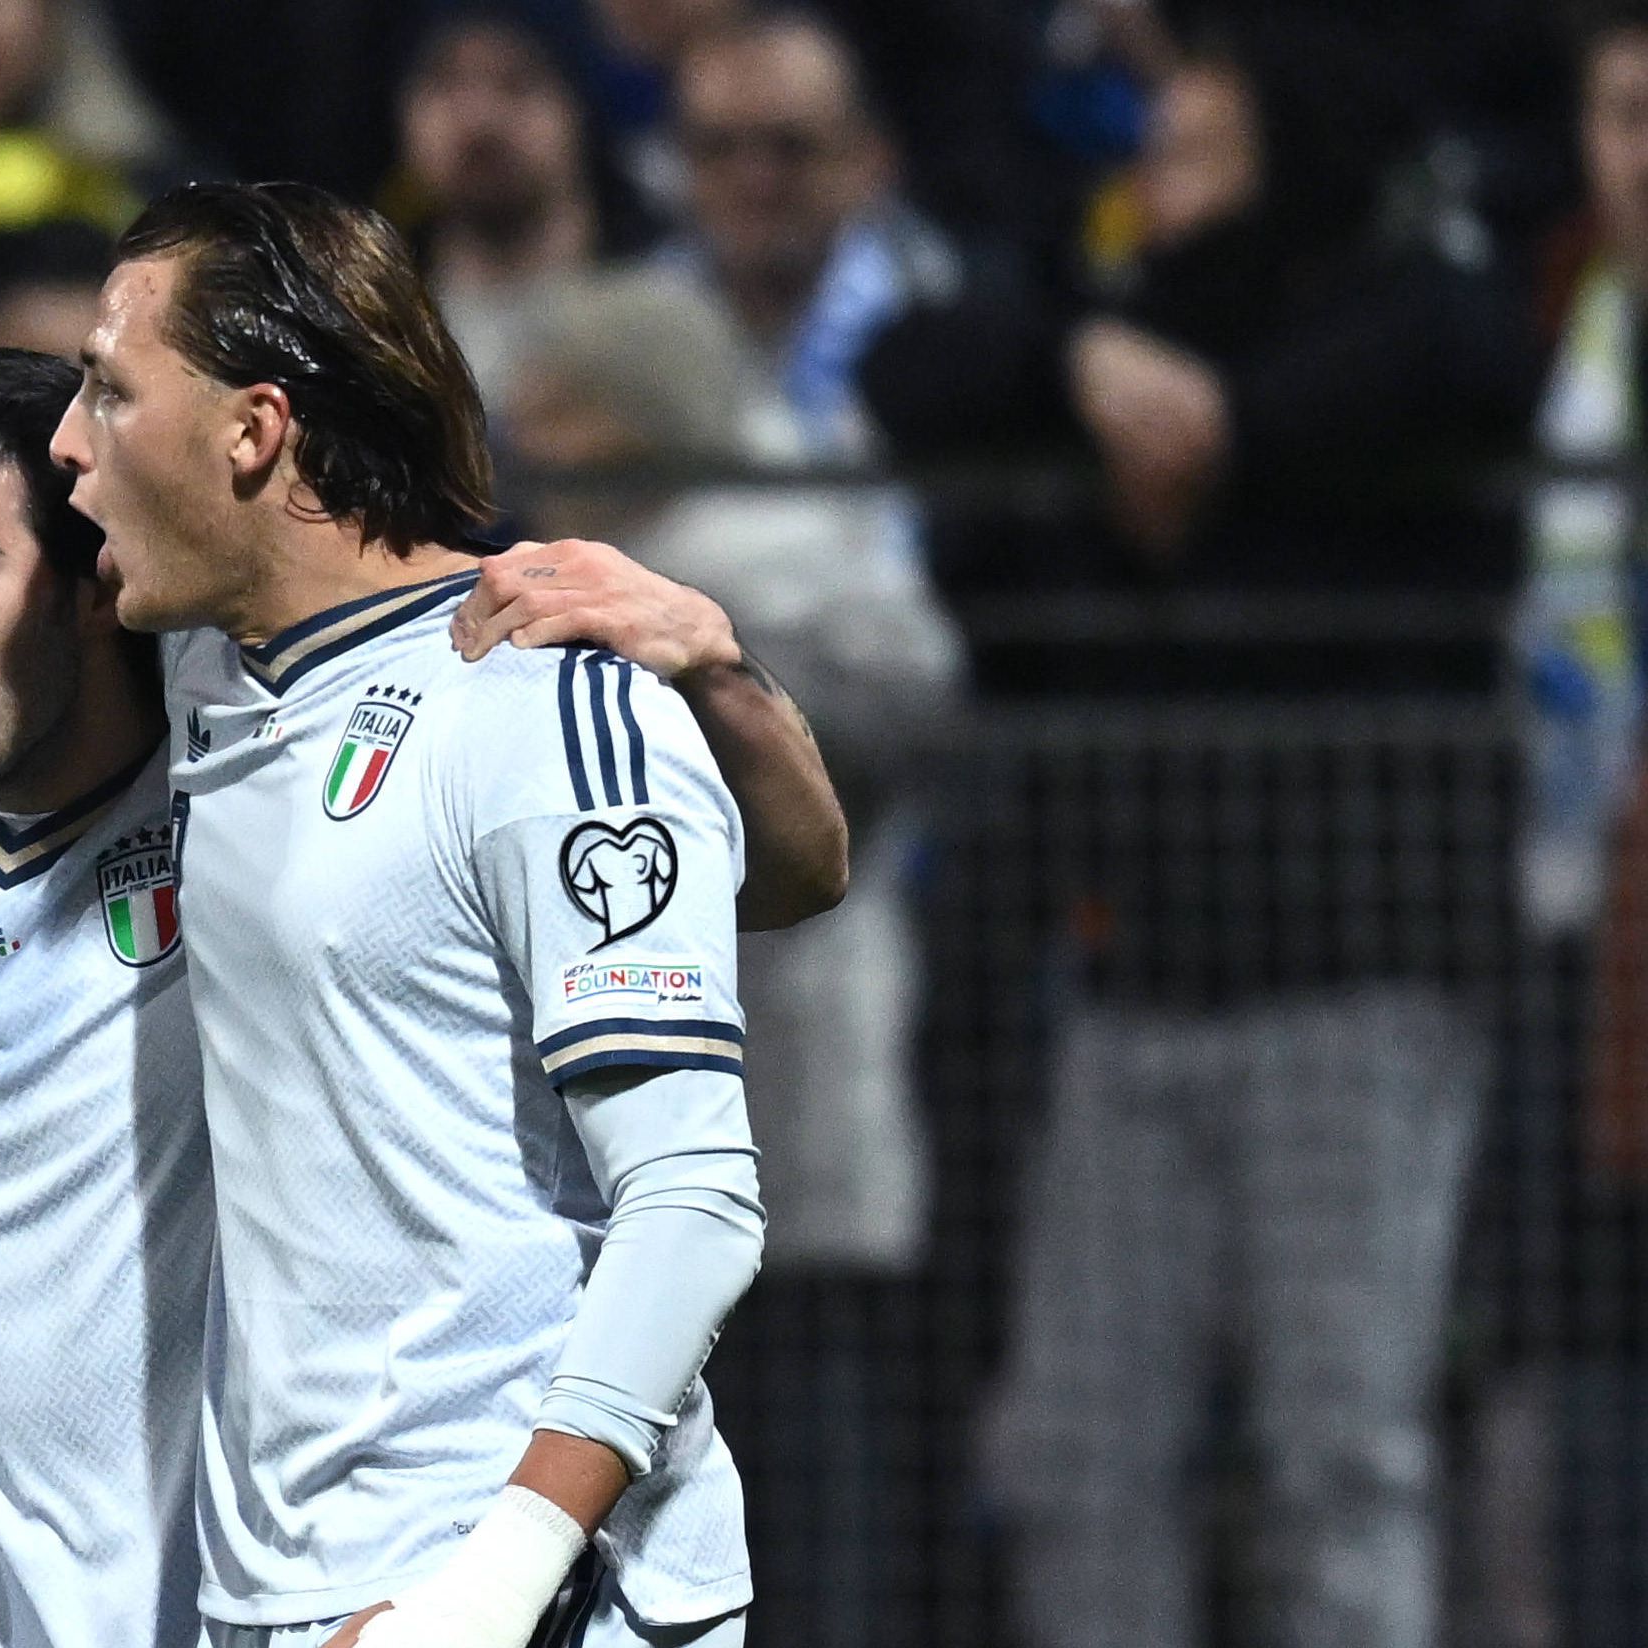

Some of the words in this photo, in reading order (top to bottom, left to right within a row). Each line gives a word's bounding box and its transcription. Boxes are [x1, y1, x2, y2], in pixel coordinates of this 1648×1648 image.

[351, 710, 402, 739] ITALIA
[104, 855, 171, 891] ITALIA
[563, 964, 595, 979] UEFA
[564, 969, 702, 998] FOUNDATION
